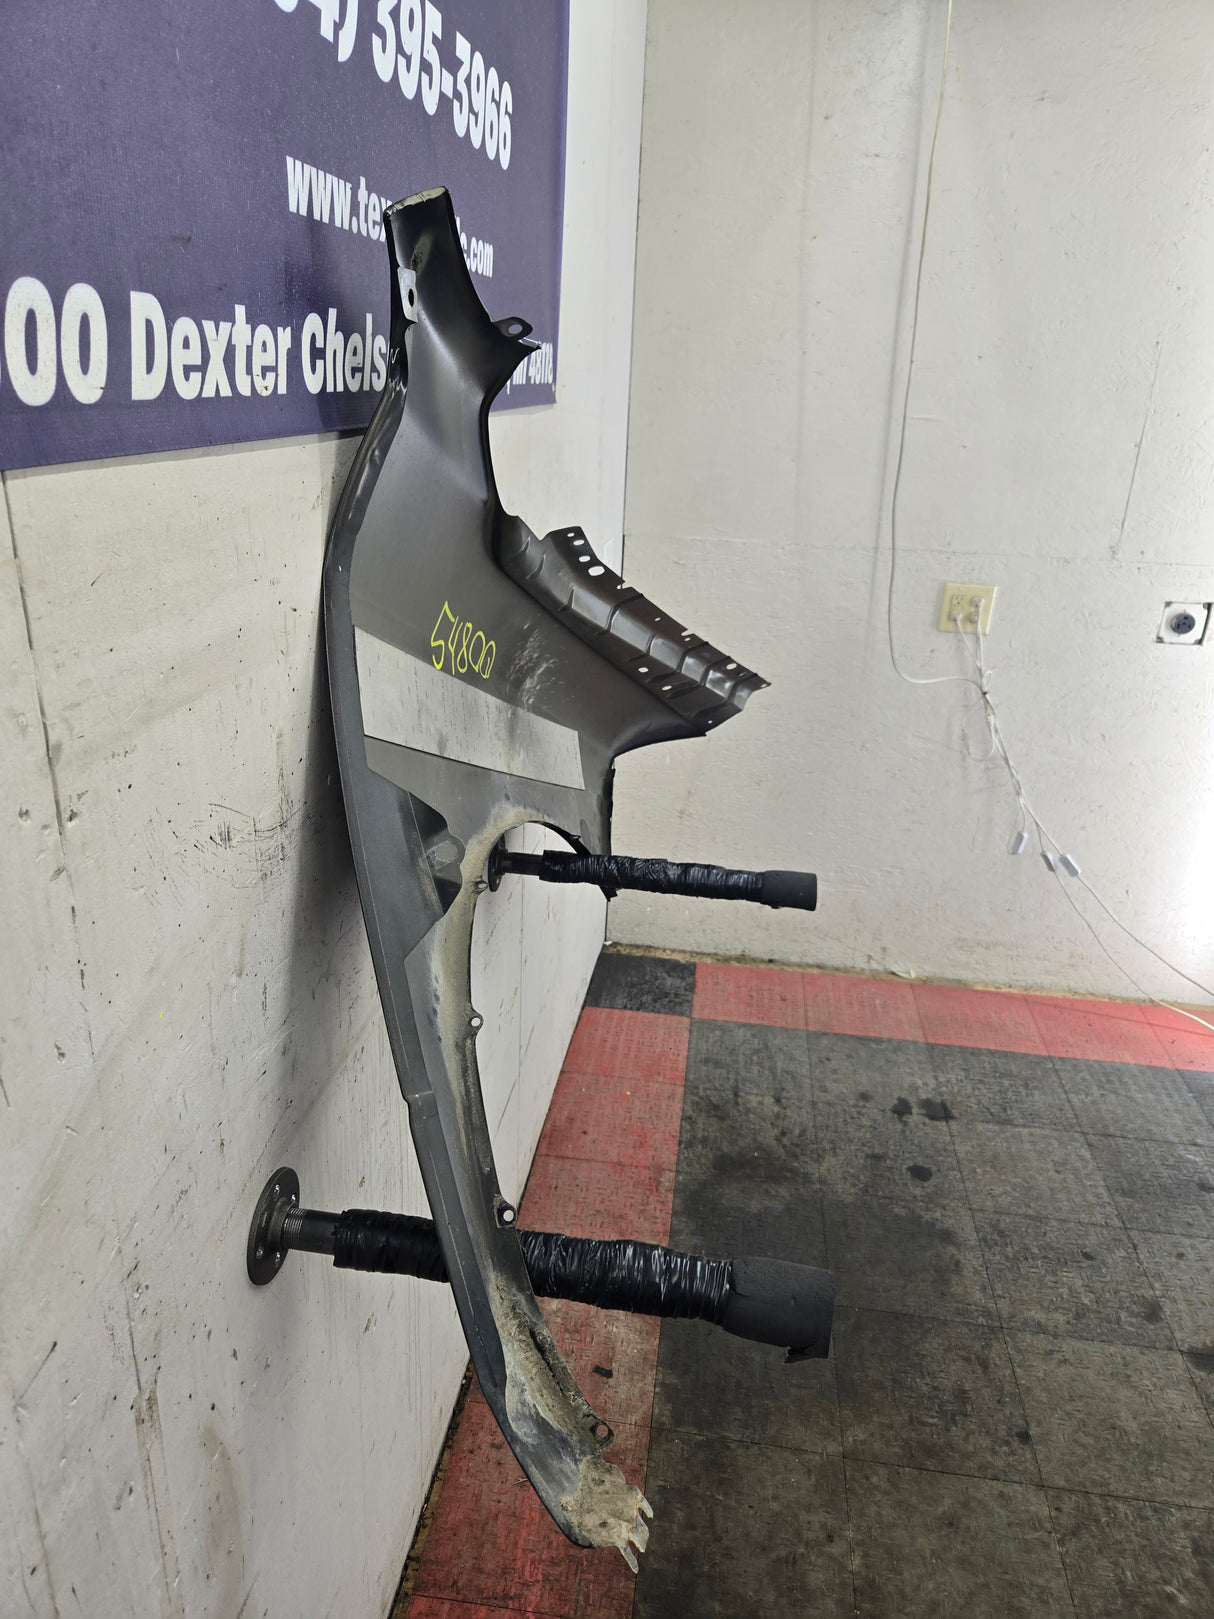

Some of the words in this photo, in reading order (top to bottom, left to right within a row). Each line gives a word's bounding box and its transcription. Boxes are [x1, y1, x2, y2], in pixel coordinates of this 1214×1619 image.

[371, 0, 513, 170] 395-3966
[0, 276, 108, 407] 00
[130, 290, 292, 401] Dexter
[301, 307, 389, 395] Chels
[430, 600, 496, 679] 54800
